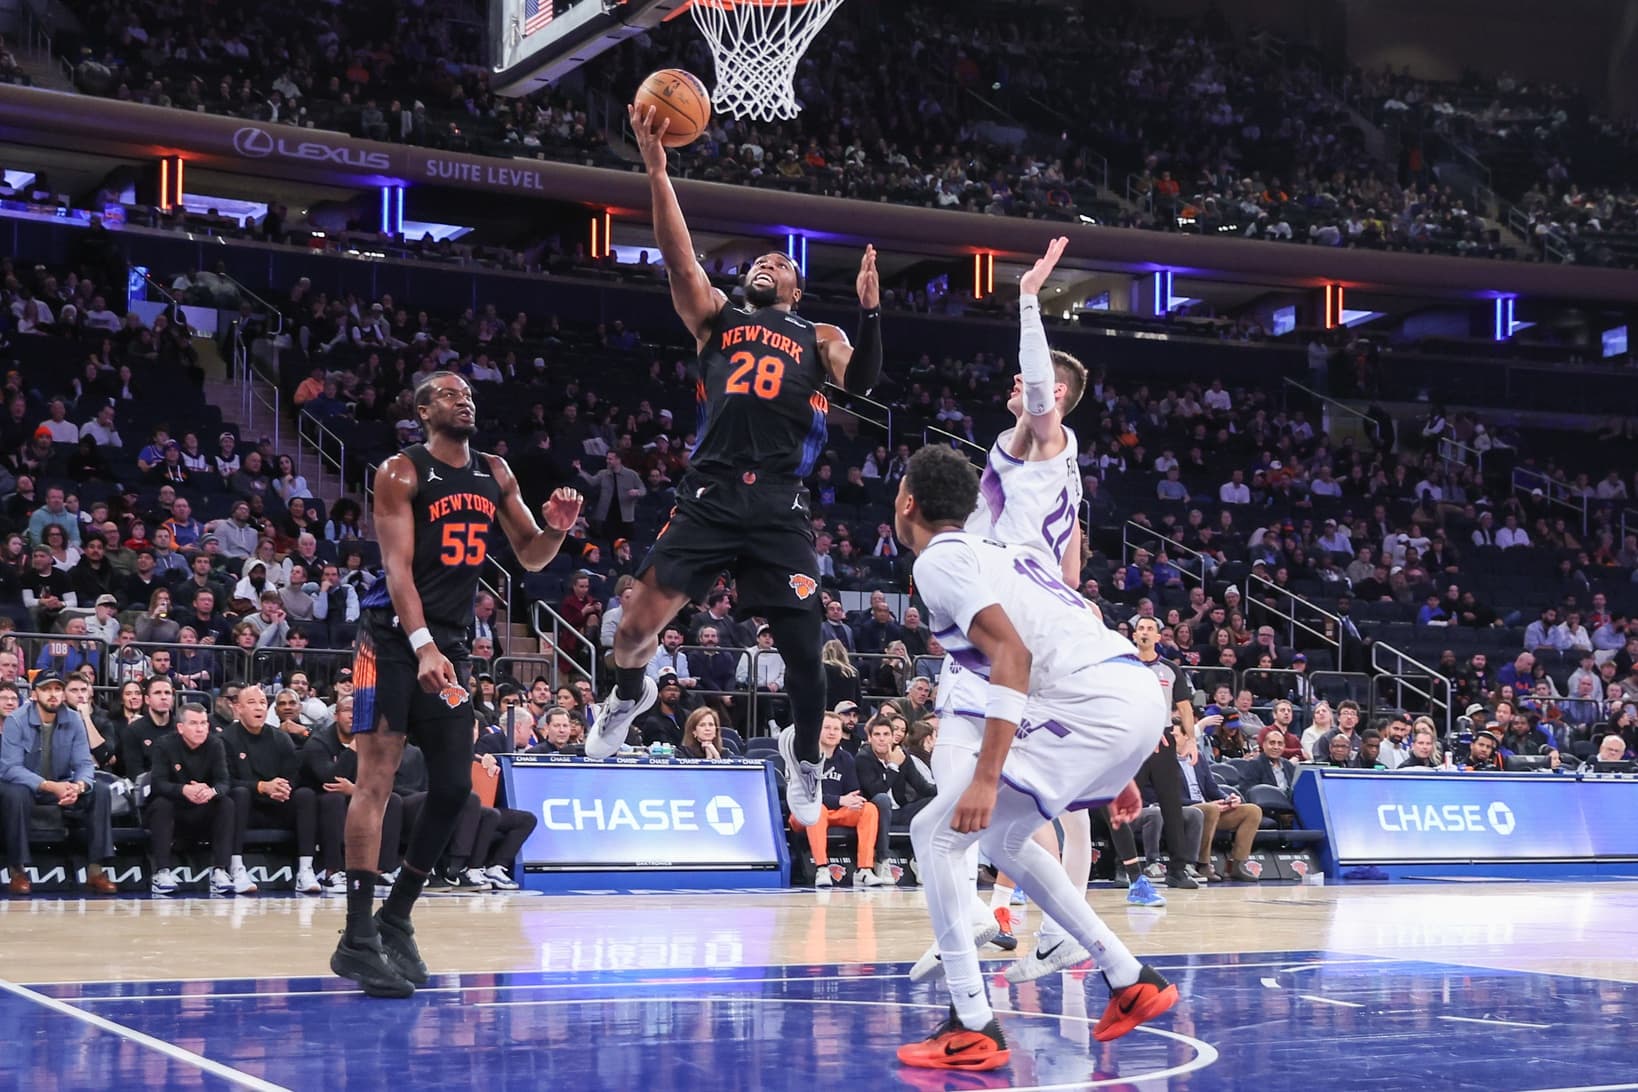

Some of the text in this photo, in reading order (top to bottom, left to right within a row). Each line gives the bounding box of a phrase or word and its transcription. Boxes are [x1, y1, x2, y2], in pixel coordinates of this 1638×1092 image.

[278, 138, 390, 170] LEXUS
[426, 158, 544, 190] SUITE LEVEL
[725, 351, 785, 400] 28
[440, 522, 488, 566] 55
[51, 643, 68, 655] 108
[542, 797, 700, 831] CHASE
[1377, 804, 1486, 832] CHASE
